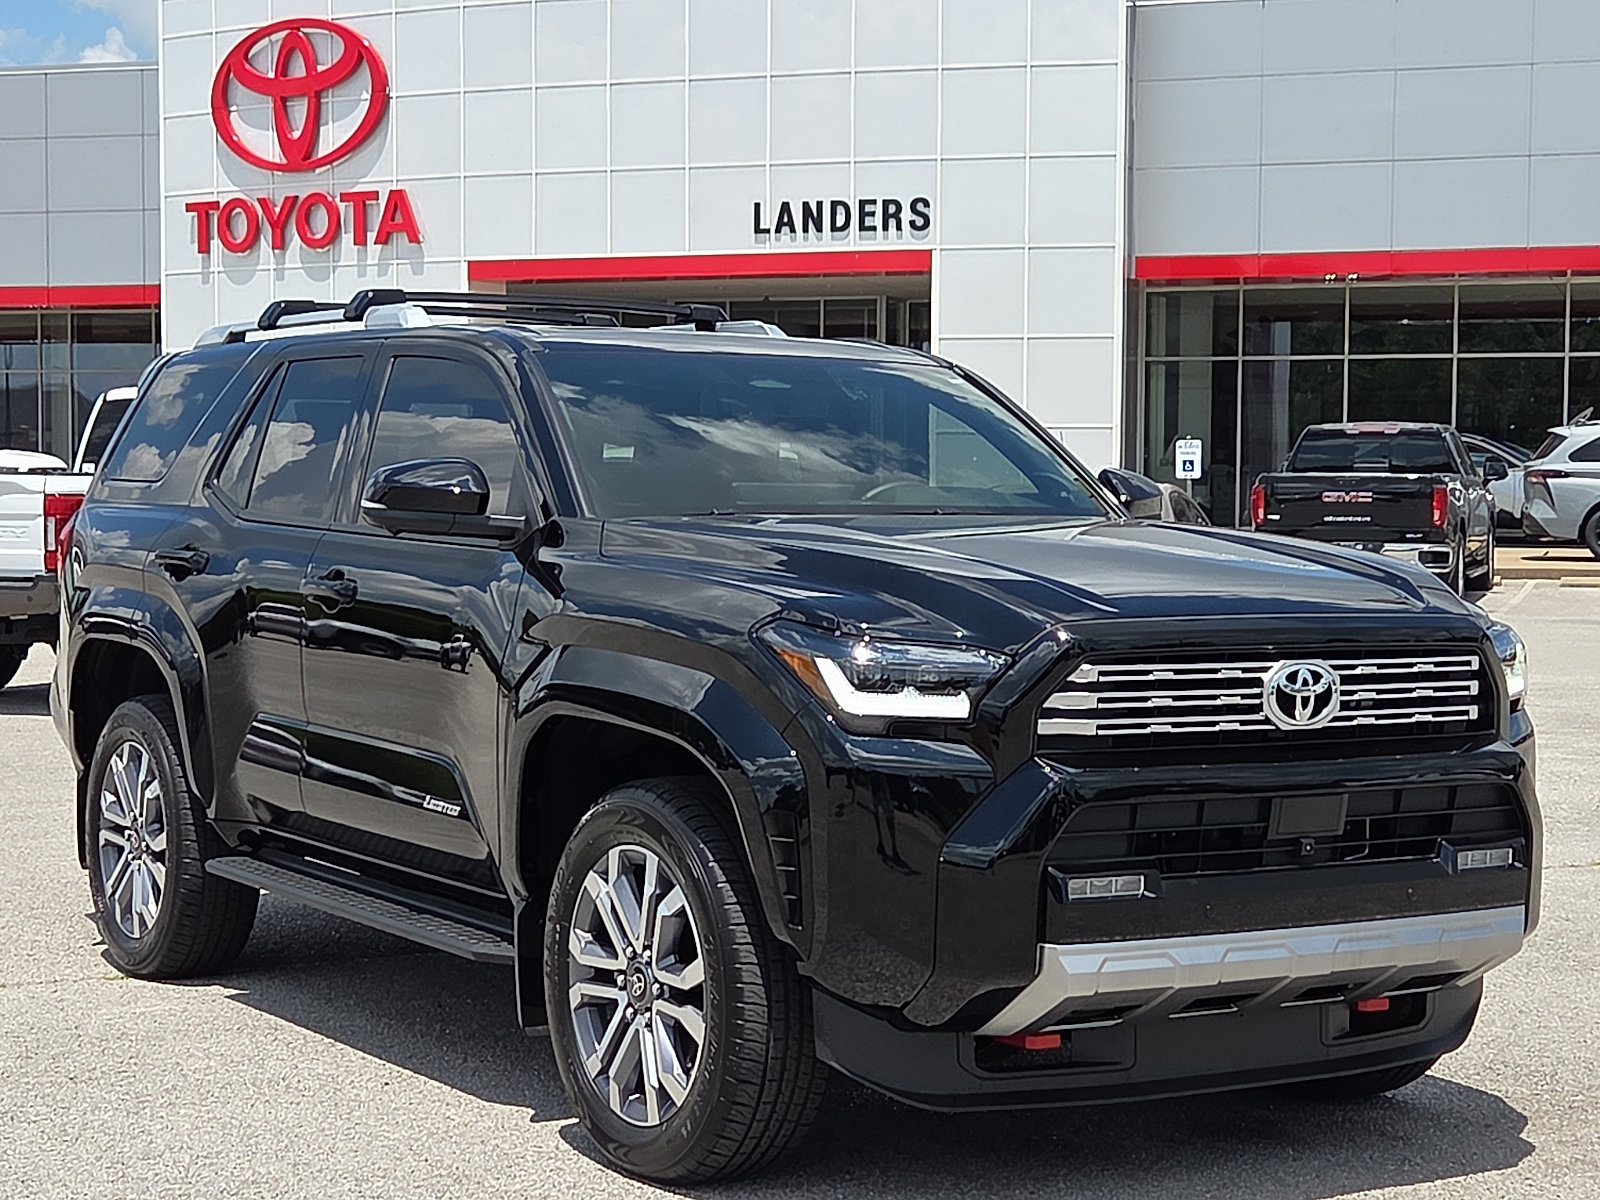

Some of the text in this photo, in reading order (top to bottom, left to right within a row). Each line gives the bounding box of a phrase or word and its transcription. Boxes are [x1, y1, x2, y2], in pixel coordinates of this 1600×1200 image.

[185, 189, 423, 255] TOYOTA
[753, 197, 931, 234] LANDERS
[1322, 491, 1373, 503] GMC
